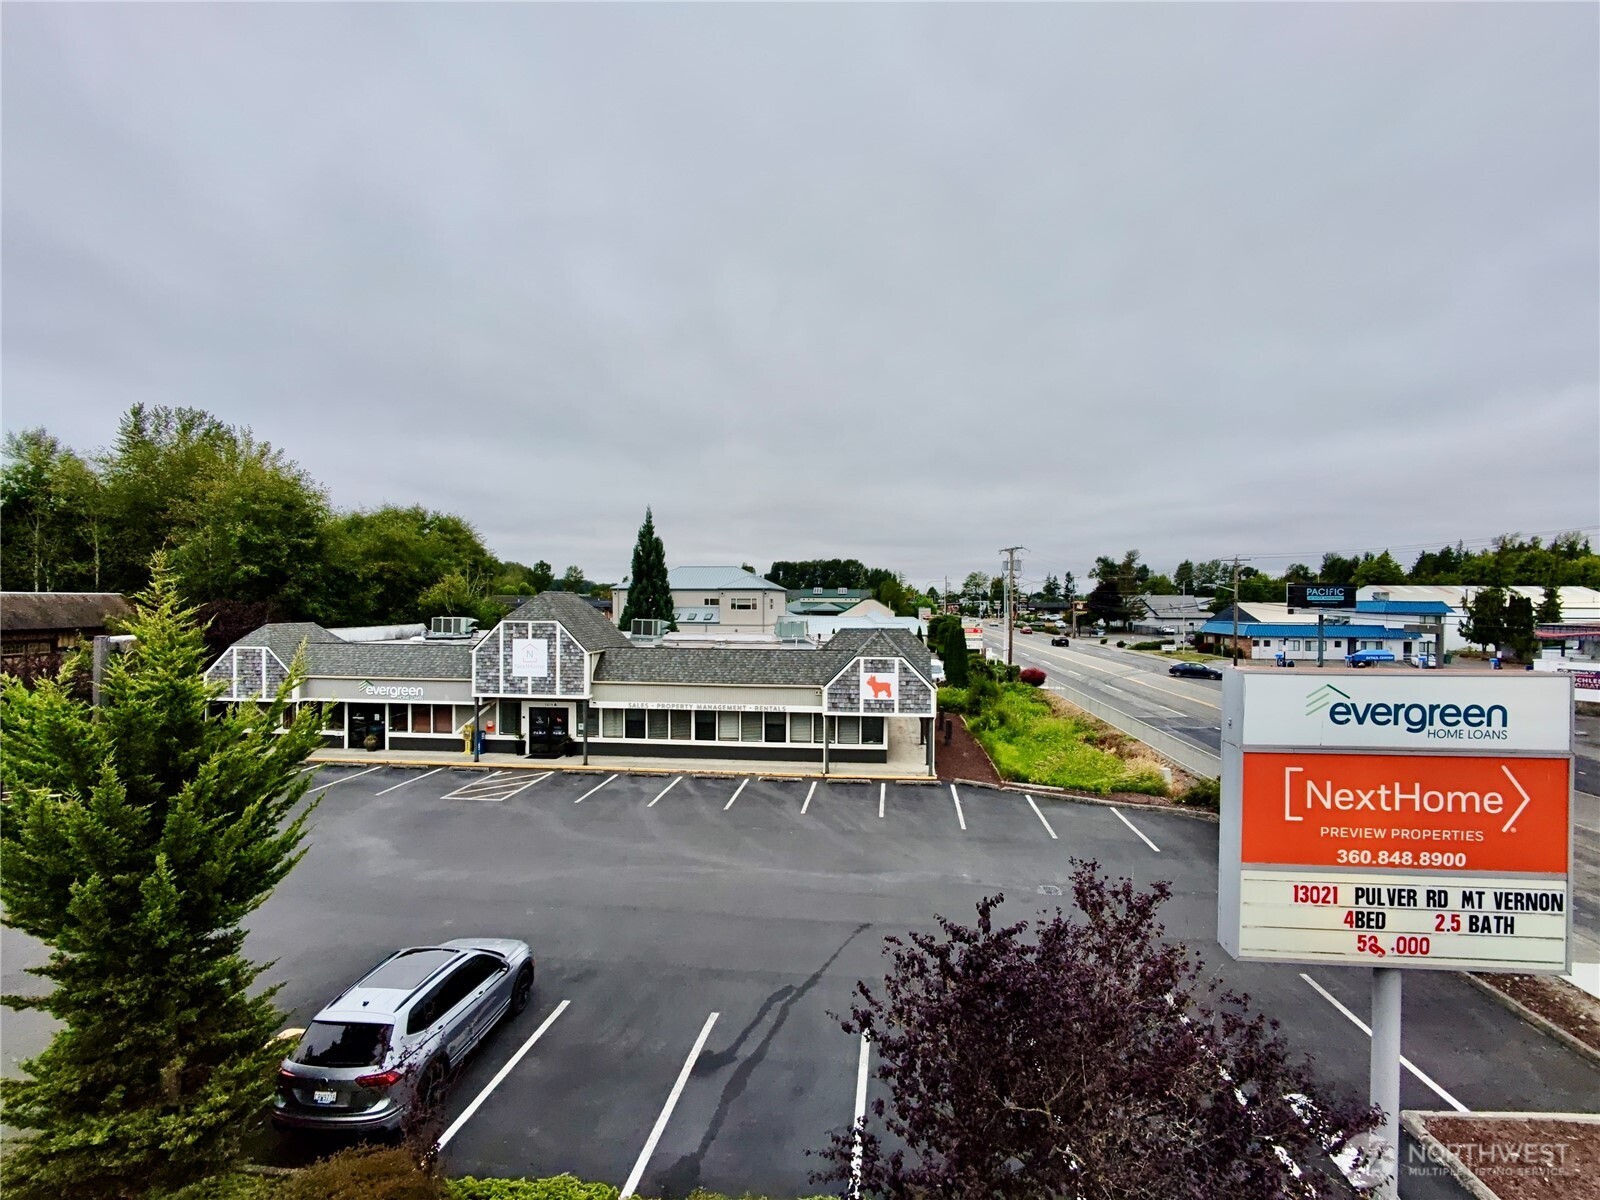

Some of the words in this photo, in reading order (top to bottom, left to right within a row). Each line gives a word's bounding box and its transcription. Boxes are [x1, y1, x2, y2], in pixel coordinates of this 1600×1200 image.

[1307, 588, 1345, 596] PACIFIC
[365, 685, 424, 698] evergreen
[1329, 702, 1508, 733] evergreen
[1427, 728, 1464, 739] HOME
[1467, 729, 1508, 740] LOANS
[1306, 779, 1504, 814] NextHome
[1320, 826, 1387, 839] PREVIEW
[1391, 828, 1485, 842] PROPERTIES
[1336, 849, 1467, 867] 360.848.8900
[1293, 884, 1338, 905] 13021
[1354, 887, 1418, 907] PULVER
[1426, 889, 1449, 908] RD
[1461, 890, 1486, 909] MT
[1493, 892, 1564, 912] VERNON
[1434, 913, 1462, 932] 2.5
[1468, 914, 1515, 935] BATH
